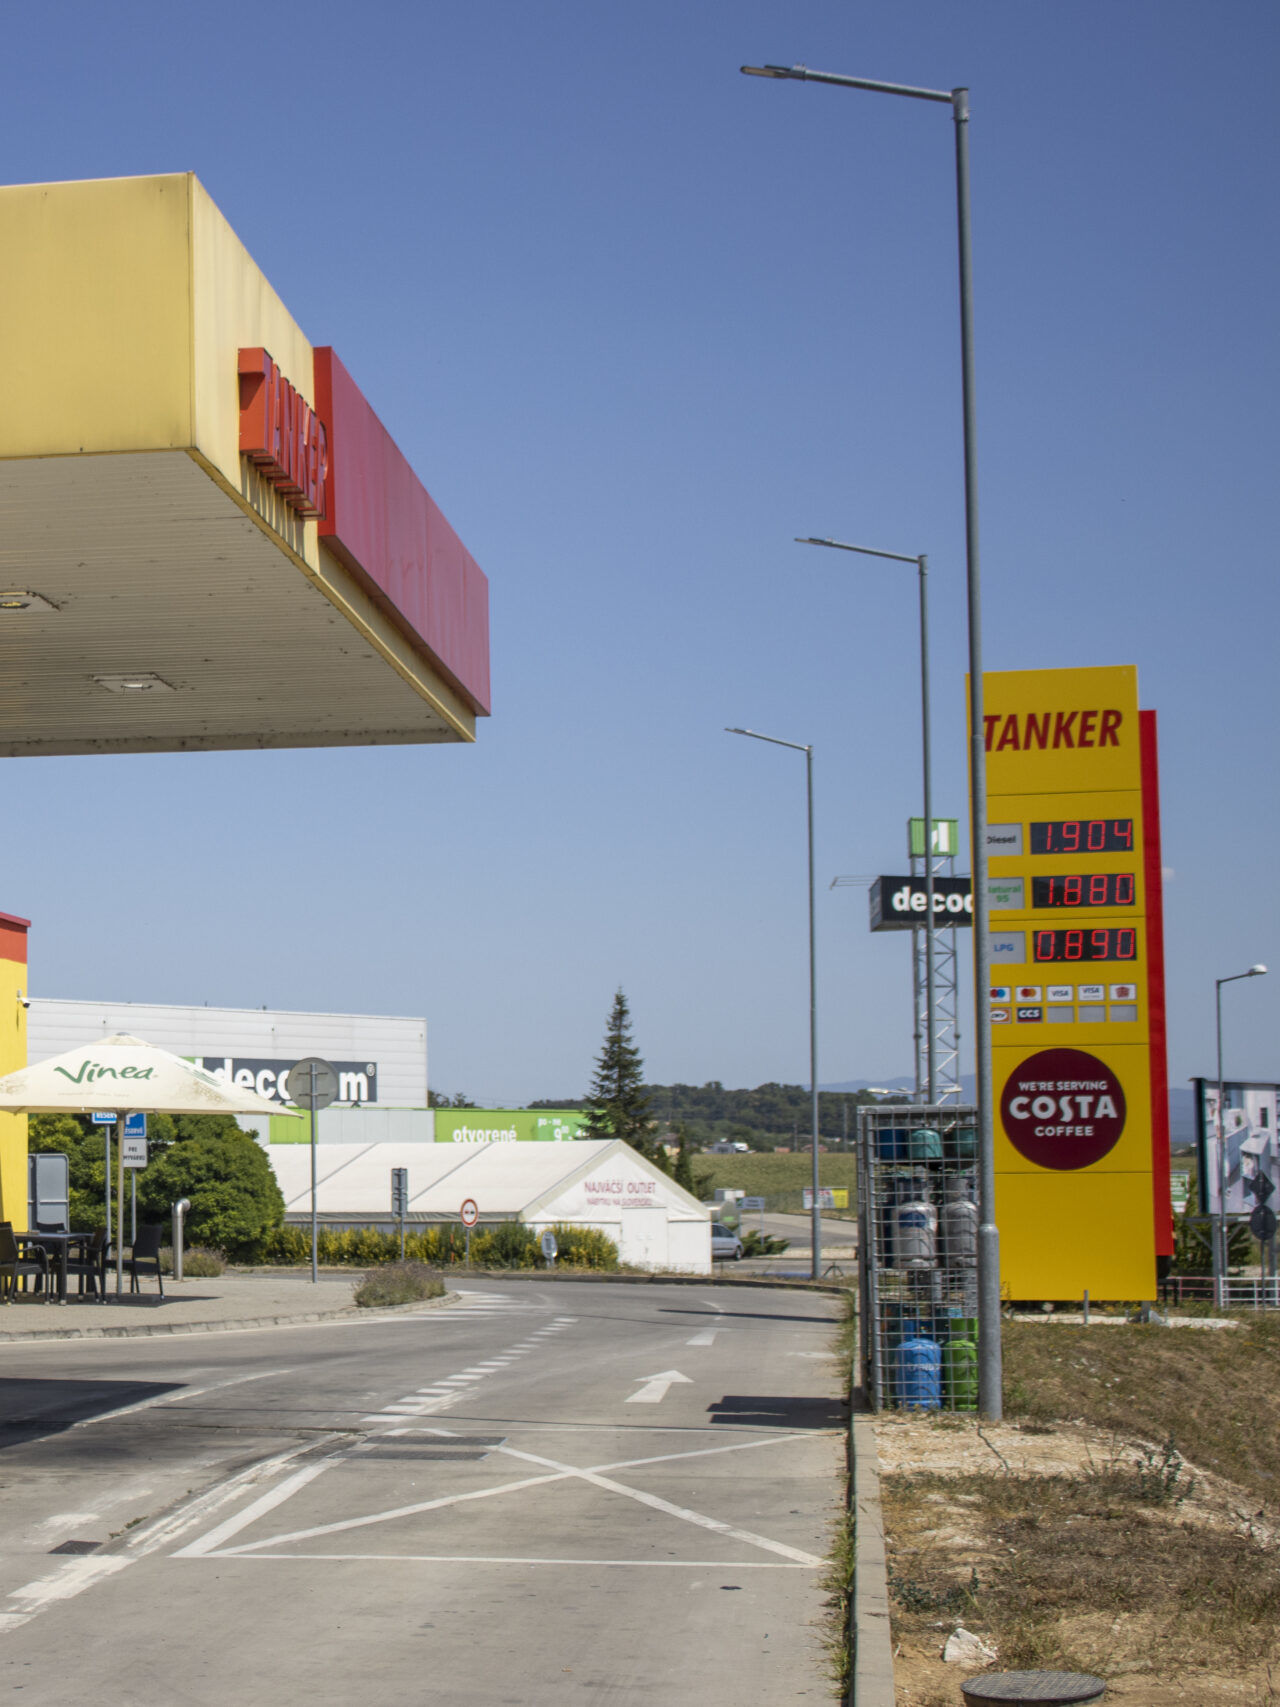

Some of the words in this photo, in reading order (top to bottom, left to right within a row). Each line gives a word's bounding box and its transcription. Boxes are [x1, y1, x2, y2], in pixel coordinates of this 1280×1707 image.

[983, 710, 1122, 752] TANKER
[1046, 821, 1132, 851] 1.904
[1048, 874, 1134, 906] 1.880
[994, 944, 1015, 952] LPG
[1037, 928, 1135, 960] 0.890
[1019, 1009, 1040, 1018] CCS
[53, 1060, 154, 1084] Vinea
[213, 1058, 368, 1101] decom
[1018, 1081, 1054, 1091] WE'RE
[1056, 1080, 1108, 1091] SERVING
[1009, 1094, 1118, 1123] COSTA
[453, 1124, 517, 1143] otvorené
[1034, 1126, 1094, 1137] COFFEE
[627, 1182, 656, 1194] OUTLET
